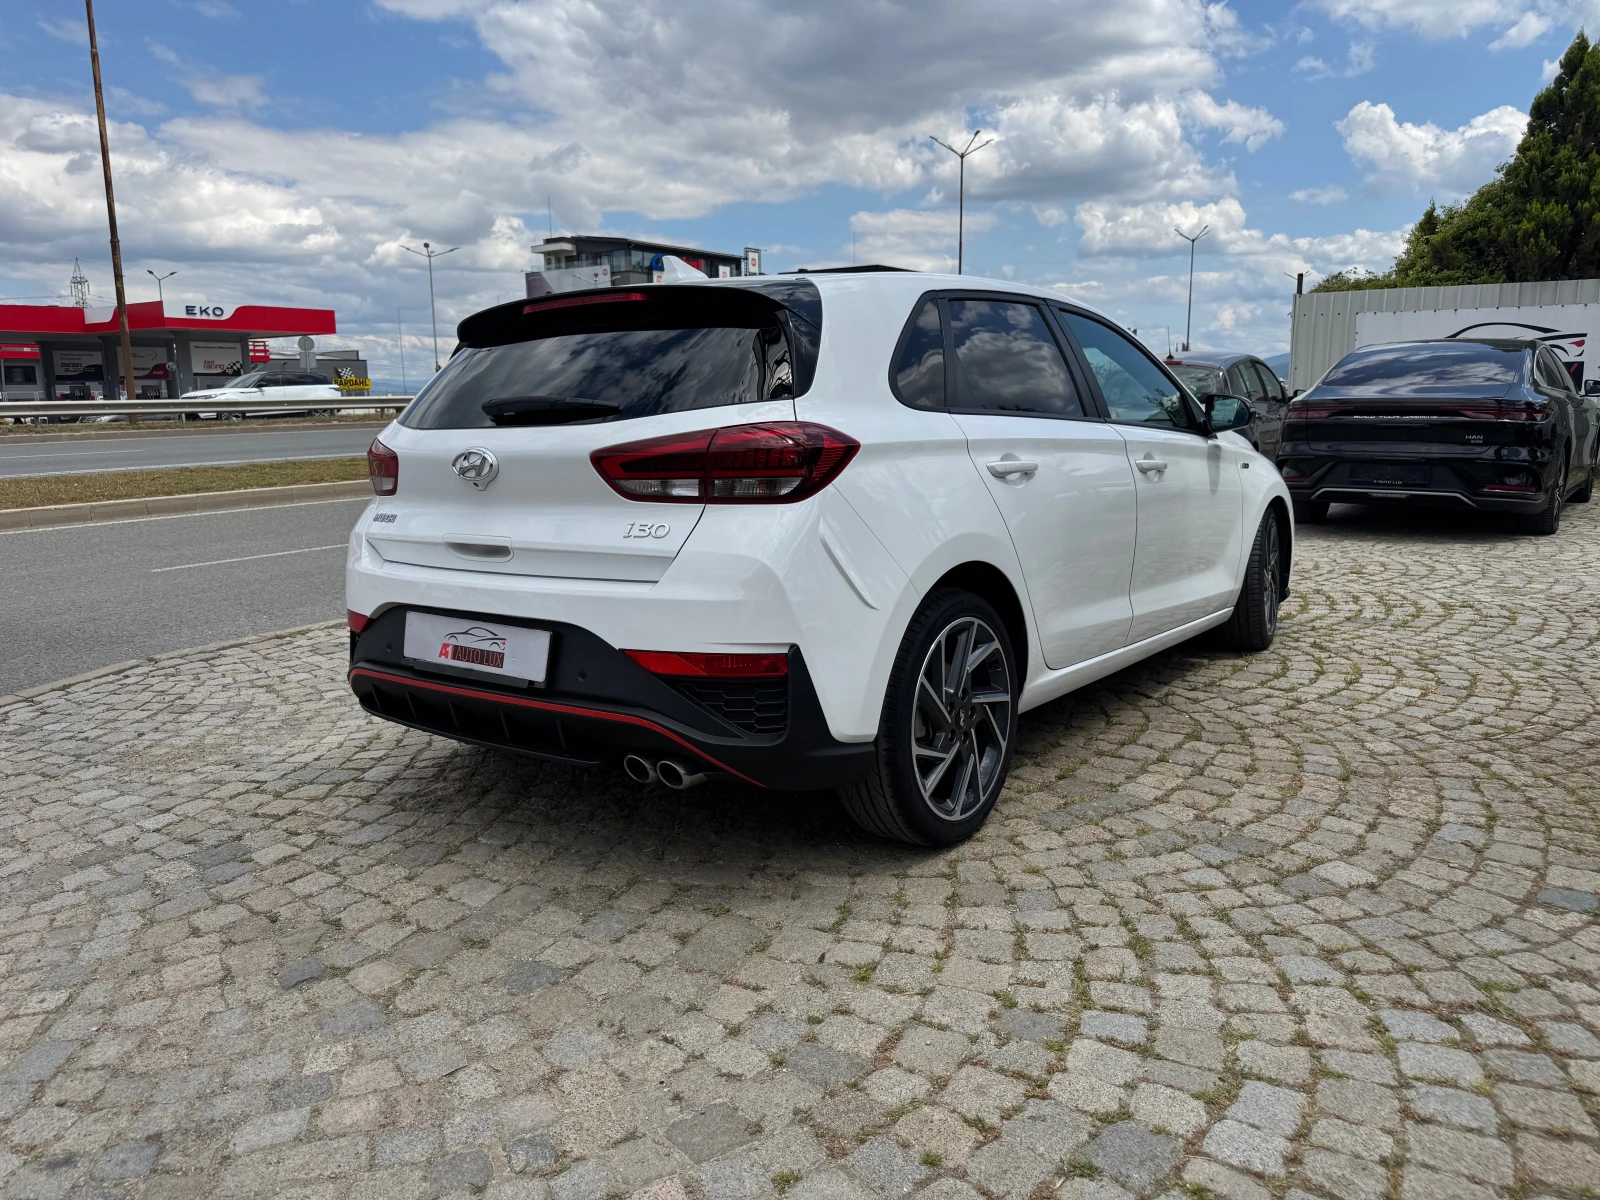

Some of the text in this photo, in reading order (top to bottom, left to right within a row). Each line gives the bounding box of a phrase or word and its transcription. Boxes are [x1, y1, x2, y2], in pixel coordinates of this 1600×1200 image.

[185, 305, 224, 317] EKO
[333, 379, 370, 388] BARDAHL
[455, 646, 481, 664] AUTO
[483, 648, 504, 667] LUX
